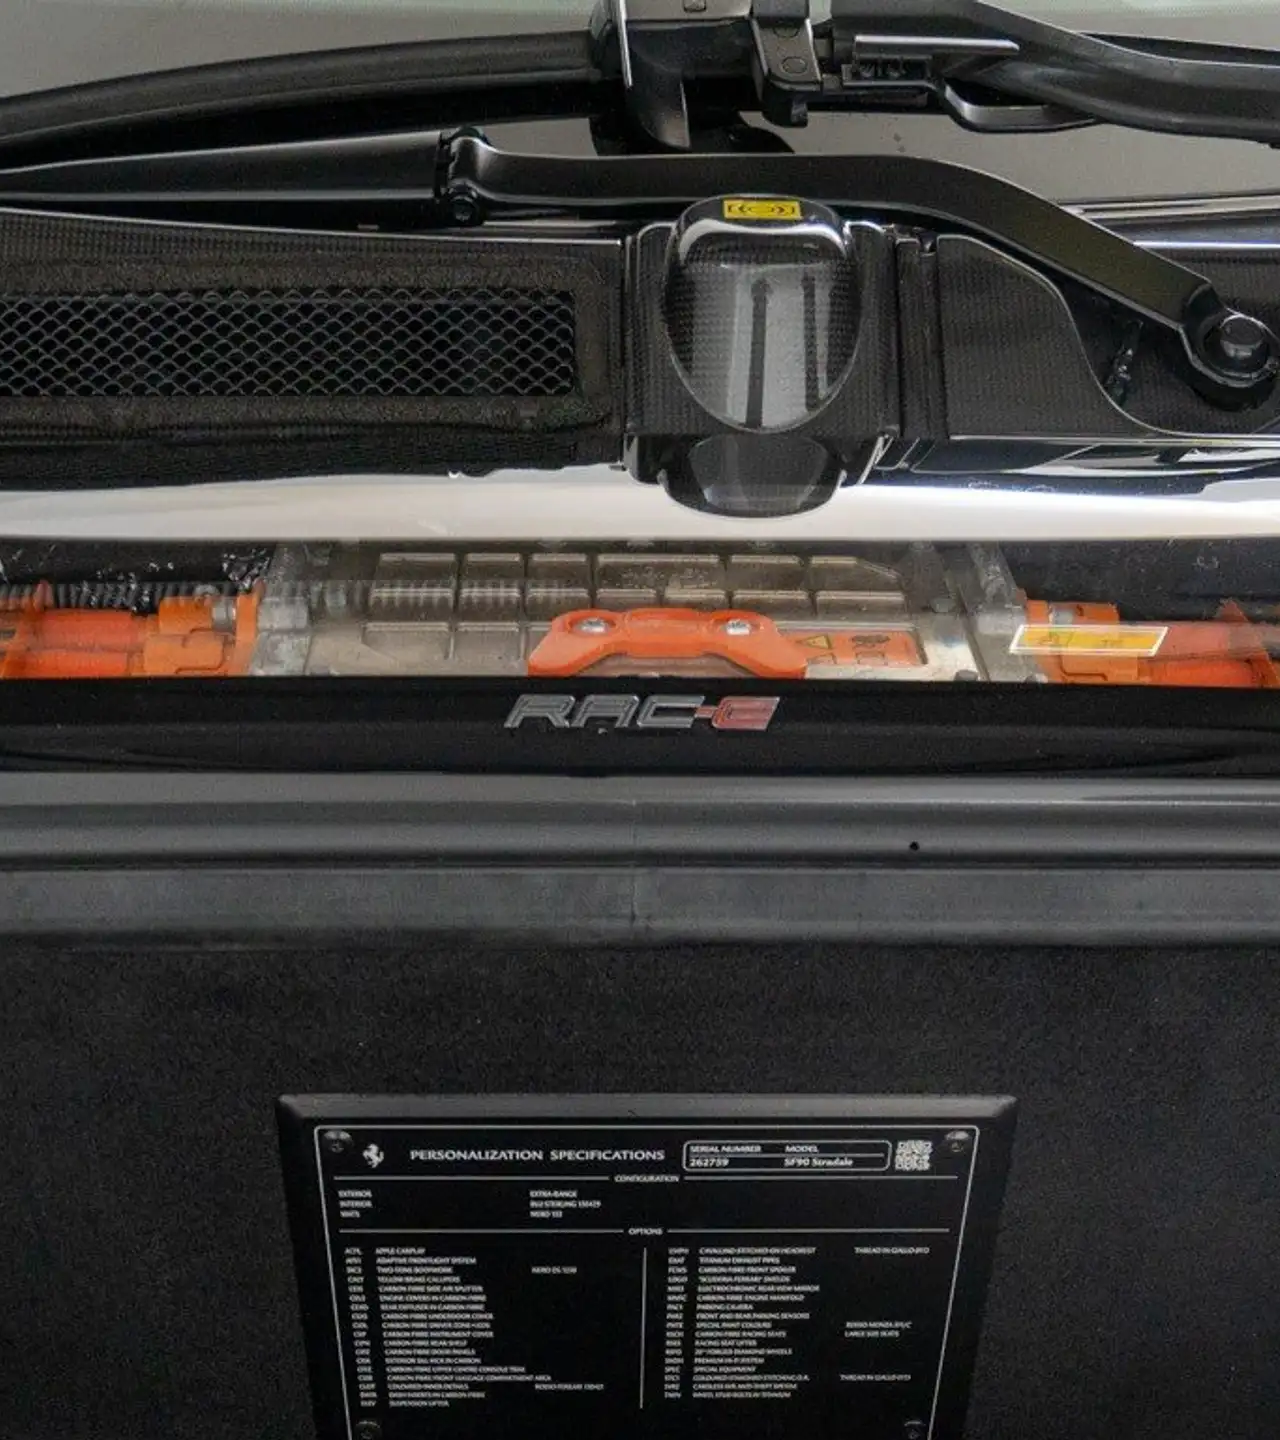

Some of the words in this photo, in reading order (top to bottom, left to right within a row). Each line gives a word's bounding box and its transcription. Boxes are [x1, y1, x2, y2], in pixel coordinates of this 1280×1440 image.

[785, 1145, 819, 1153] MODEL
[410, 1150, 543, 1161] PERSONALIZATION
[550, 1150, 665, 1161] SPECIFICATIONS
[812, 1158, 853, 1167] Stradale
